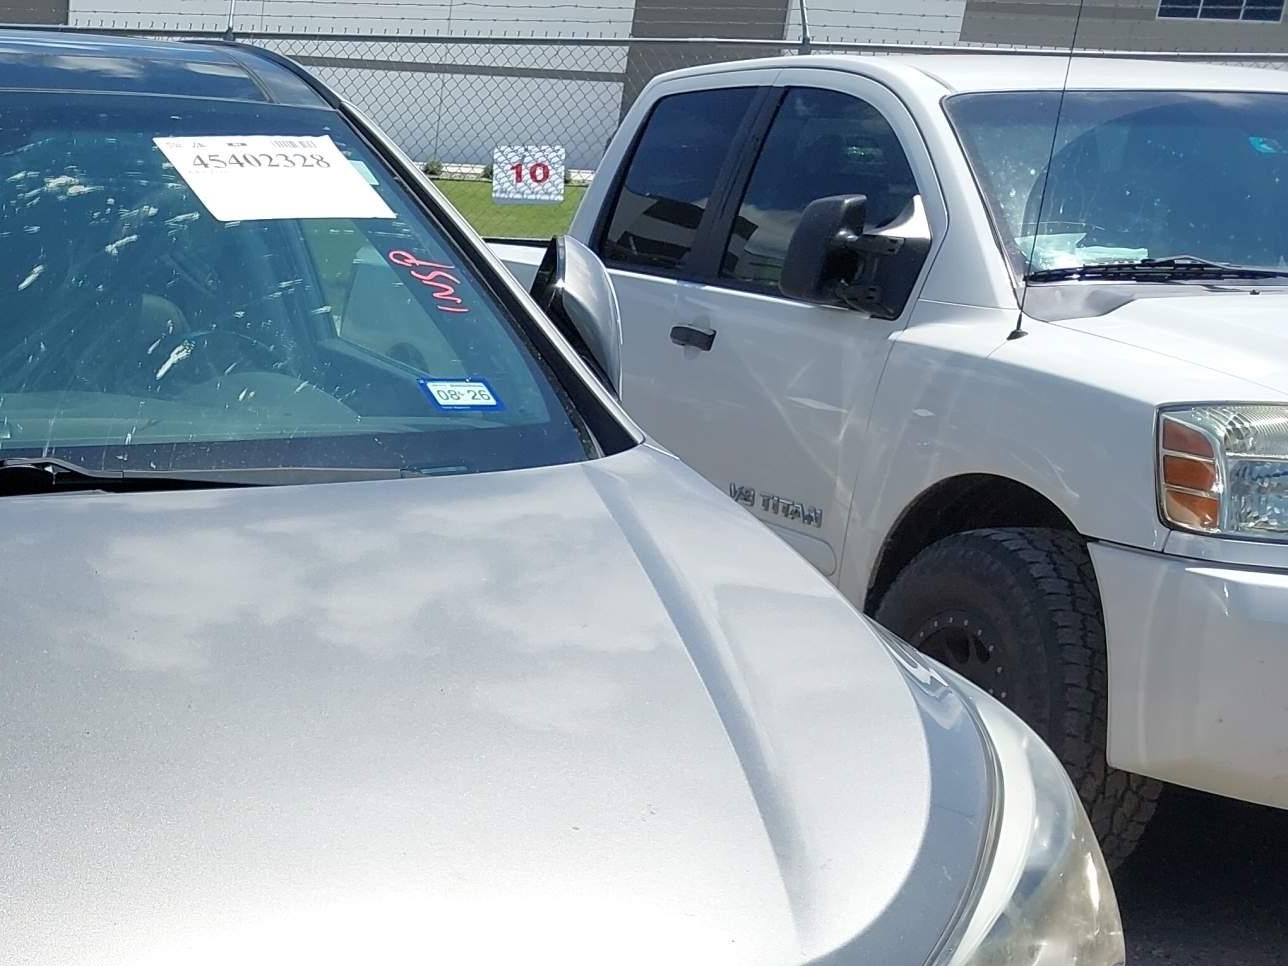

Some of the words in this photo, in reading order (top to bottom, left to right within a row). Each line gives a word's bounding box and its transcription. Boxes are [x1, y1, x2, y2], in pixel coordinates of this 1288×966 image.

[192, 153, 330, 169] 45402328
[510, 163, 550, 184] 10
[728, 481, 756, 507] V8
[759, 492, 823, 528] TITAN
